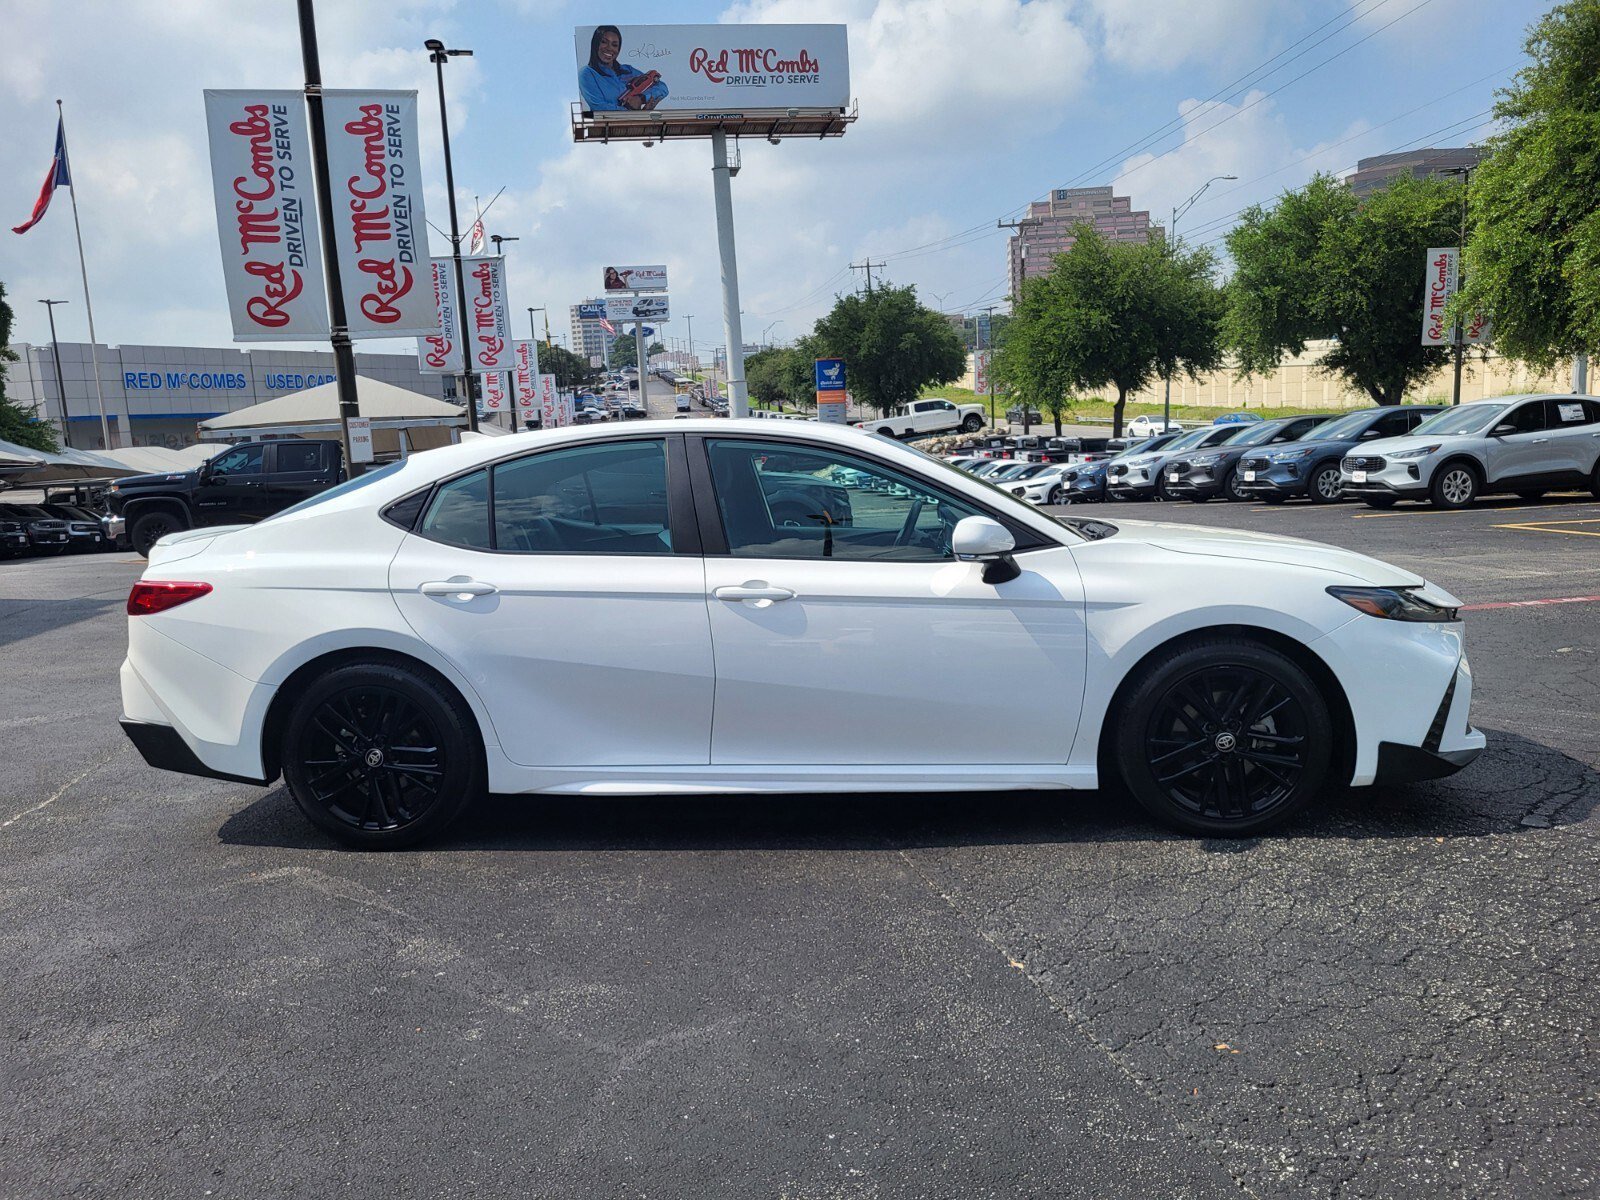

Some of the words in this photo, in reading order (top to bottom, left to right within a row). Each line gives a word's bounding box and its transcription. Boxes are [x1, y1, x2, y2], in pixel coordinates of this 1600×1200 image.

[690, 48, 729, 83] Red
[731, 48, 819, 74] McCombs
[726, 76, 766, 85] DRIVEN
[770, 75, 784, 84] TO
[787, 74, 820, 84] SERVE
[272, 104, 292, 160] SERVE
[386, 104, 403, 158] SERVE
[230, 104, 281, 256] McCombs
[278, 166, 295, 192] TO
[344, 104, 392, 254] McCombs
[390, 164, 405, 188] TO
[280, 198, 304, 268] DRIVEN
[391, 194, 413, 264] DRIVEN
[438, 262, 447, 290] SERVE
[490, 262, 500, 288] SERVE
[1430, 254, 1448, 312] McCombs
[1447, 278, 1452, 288] TO
[244, 261, 304, 327] Red
[358, 258, 414, 324] Red
[442, 292, 450, 305] TO
[472, 262, 494, 332] McCombs
[493, 292, 502, 304] TO
[440, 312, 452, 340] DRIVEN
[426, 334, 452, 368] Red
[478, 336, 504, 366] Red
[516, 343, 530, 386] McCombs
[124, 372, 162, 390] RED
[266, 374, 304, 390] USED
[487, 389, 504, 408] Red
[519, 388, 536, 406] Red
